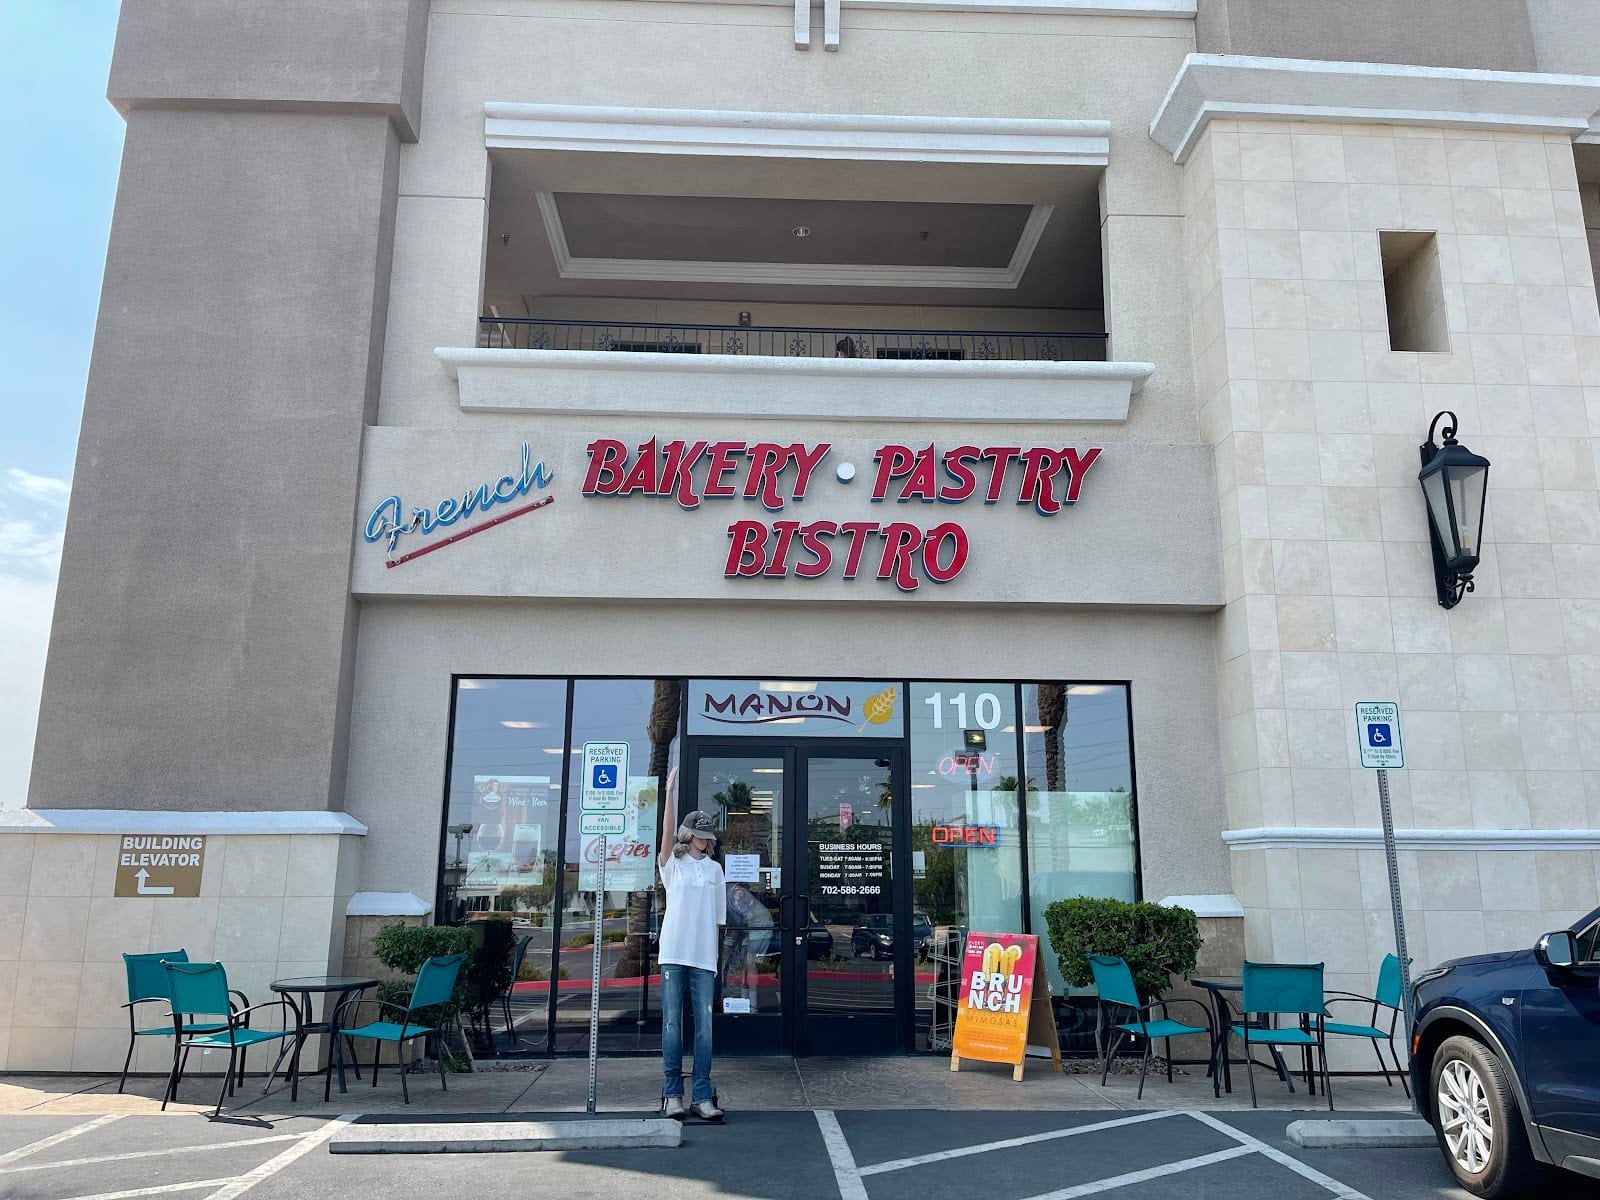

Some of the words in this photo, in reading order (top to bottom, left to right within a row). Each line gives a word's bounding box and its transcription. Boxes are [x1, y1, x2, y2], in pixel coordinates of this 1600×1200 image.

[581, 434, 832, 512] BAKERY
[870, 441, 1103, 517] PASTRY
[363, 441, 554, 560] French
[724, 520, 970, 593] BISTRO
[705, 693, 851, 717] MANON
[924, 692, 1001, 730] 110
[1360, 707, 1393, 715] RESERVED
[1363, 715, 1392, 723] PARKING
[589, 748, 623, 756] RESERVED
[938, 756, 995, 775] OPEN
[123, 837, 202, 850] BUILDING
[931, 826, 996, 845] OPEN
[819, 843, 855, 851] BUSINESS
[856, 843, 882, 851] HOURS
[121, 853, 200, 867] ELEVATOR
[821, 885, 881, 895] 702-586-2666
[971, 970, 1023, 994] BRU
[968, 989, 1021, 1014] NCH
[965, 1014, 1019, 1028] MIMOSAS
